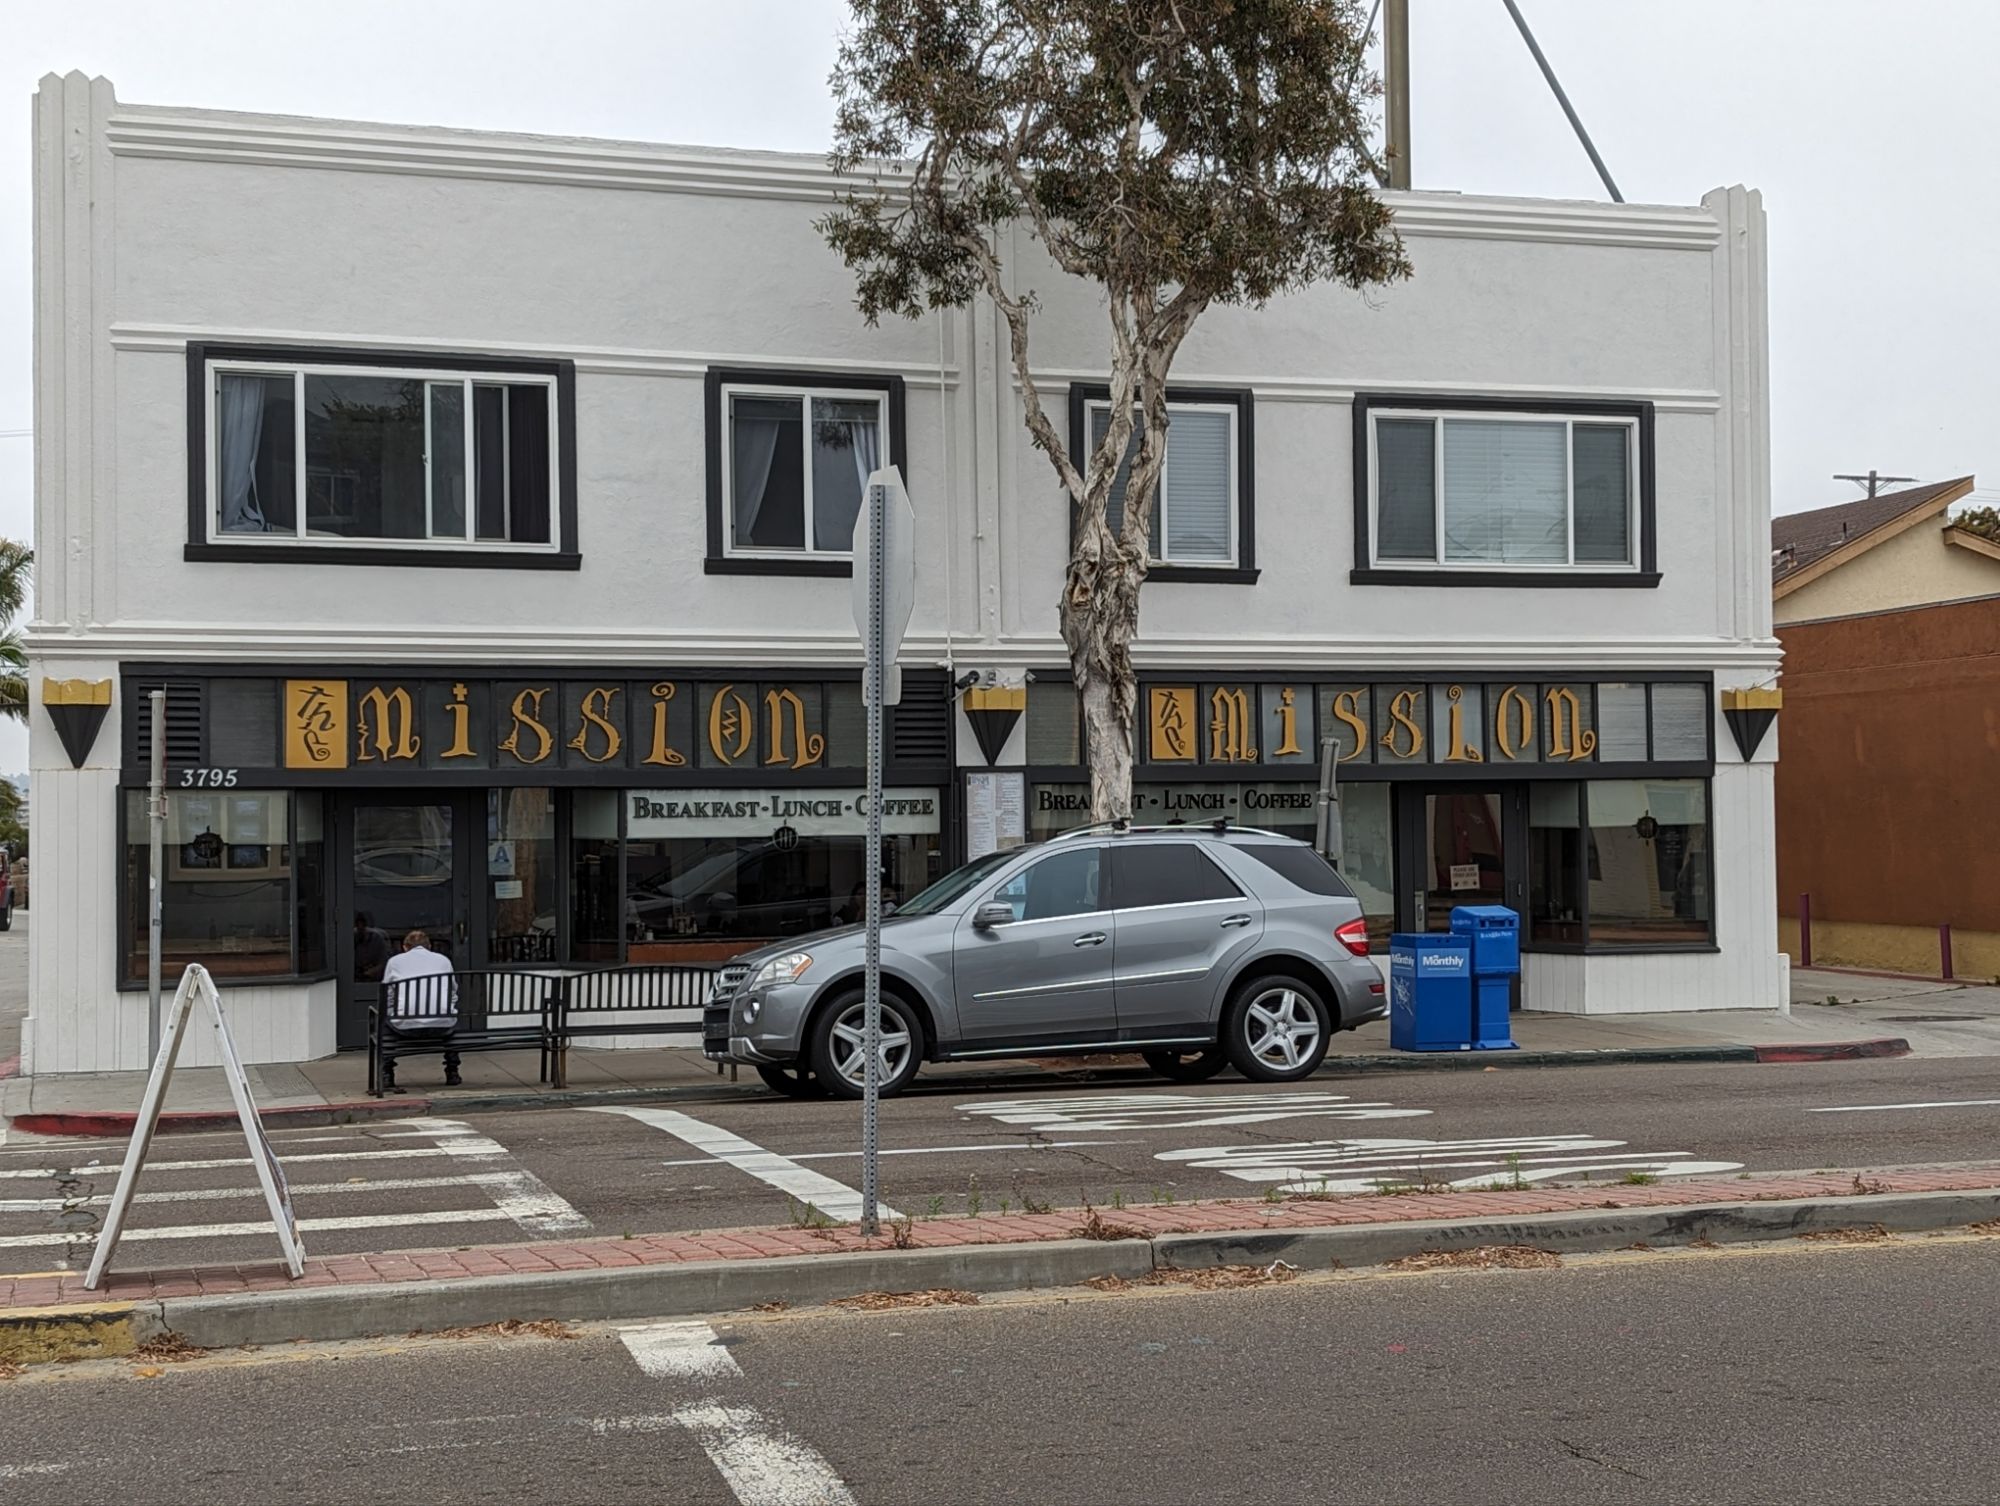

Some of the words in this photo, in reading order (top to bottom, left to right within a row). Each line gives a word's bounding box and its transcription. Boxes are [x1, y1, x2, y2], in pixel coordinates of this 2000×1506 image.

[180, 769, 239, 788] 3795
[632, 796, 759, 819] BREAKFAST
[771, 795, 843, 818] LUNCH
[855, 794, 934, 816] CFFEE
[1038, 790, 1146, 811] BREAT
[1163, 789, 1225, 811] LUNCH
[1243, 788, 1312, 810] COFFEE
[494, 846, 510, 862] A
[1422, 954, 1464, 967] Monthly
